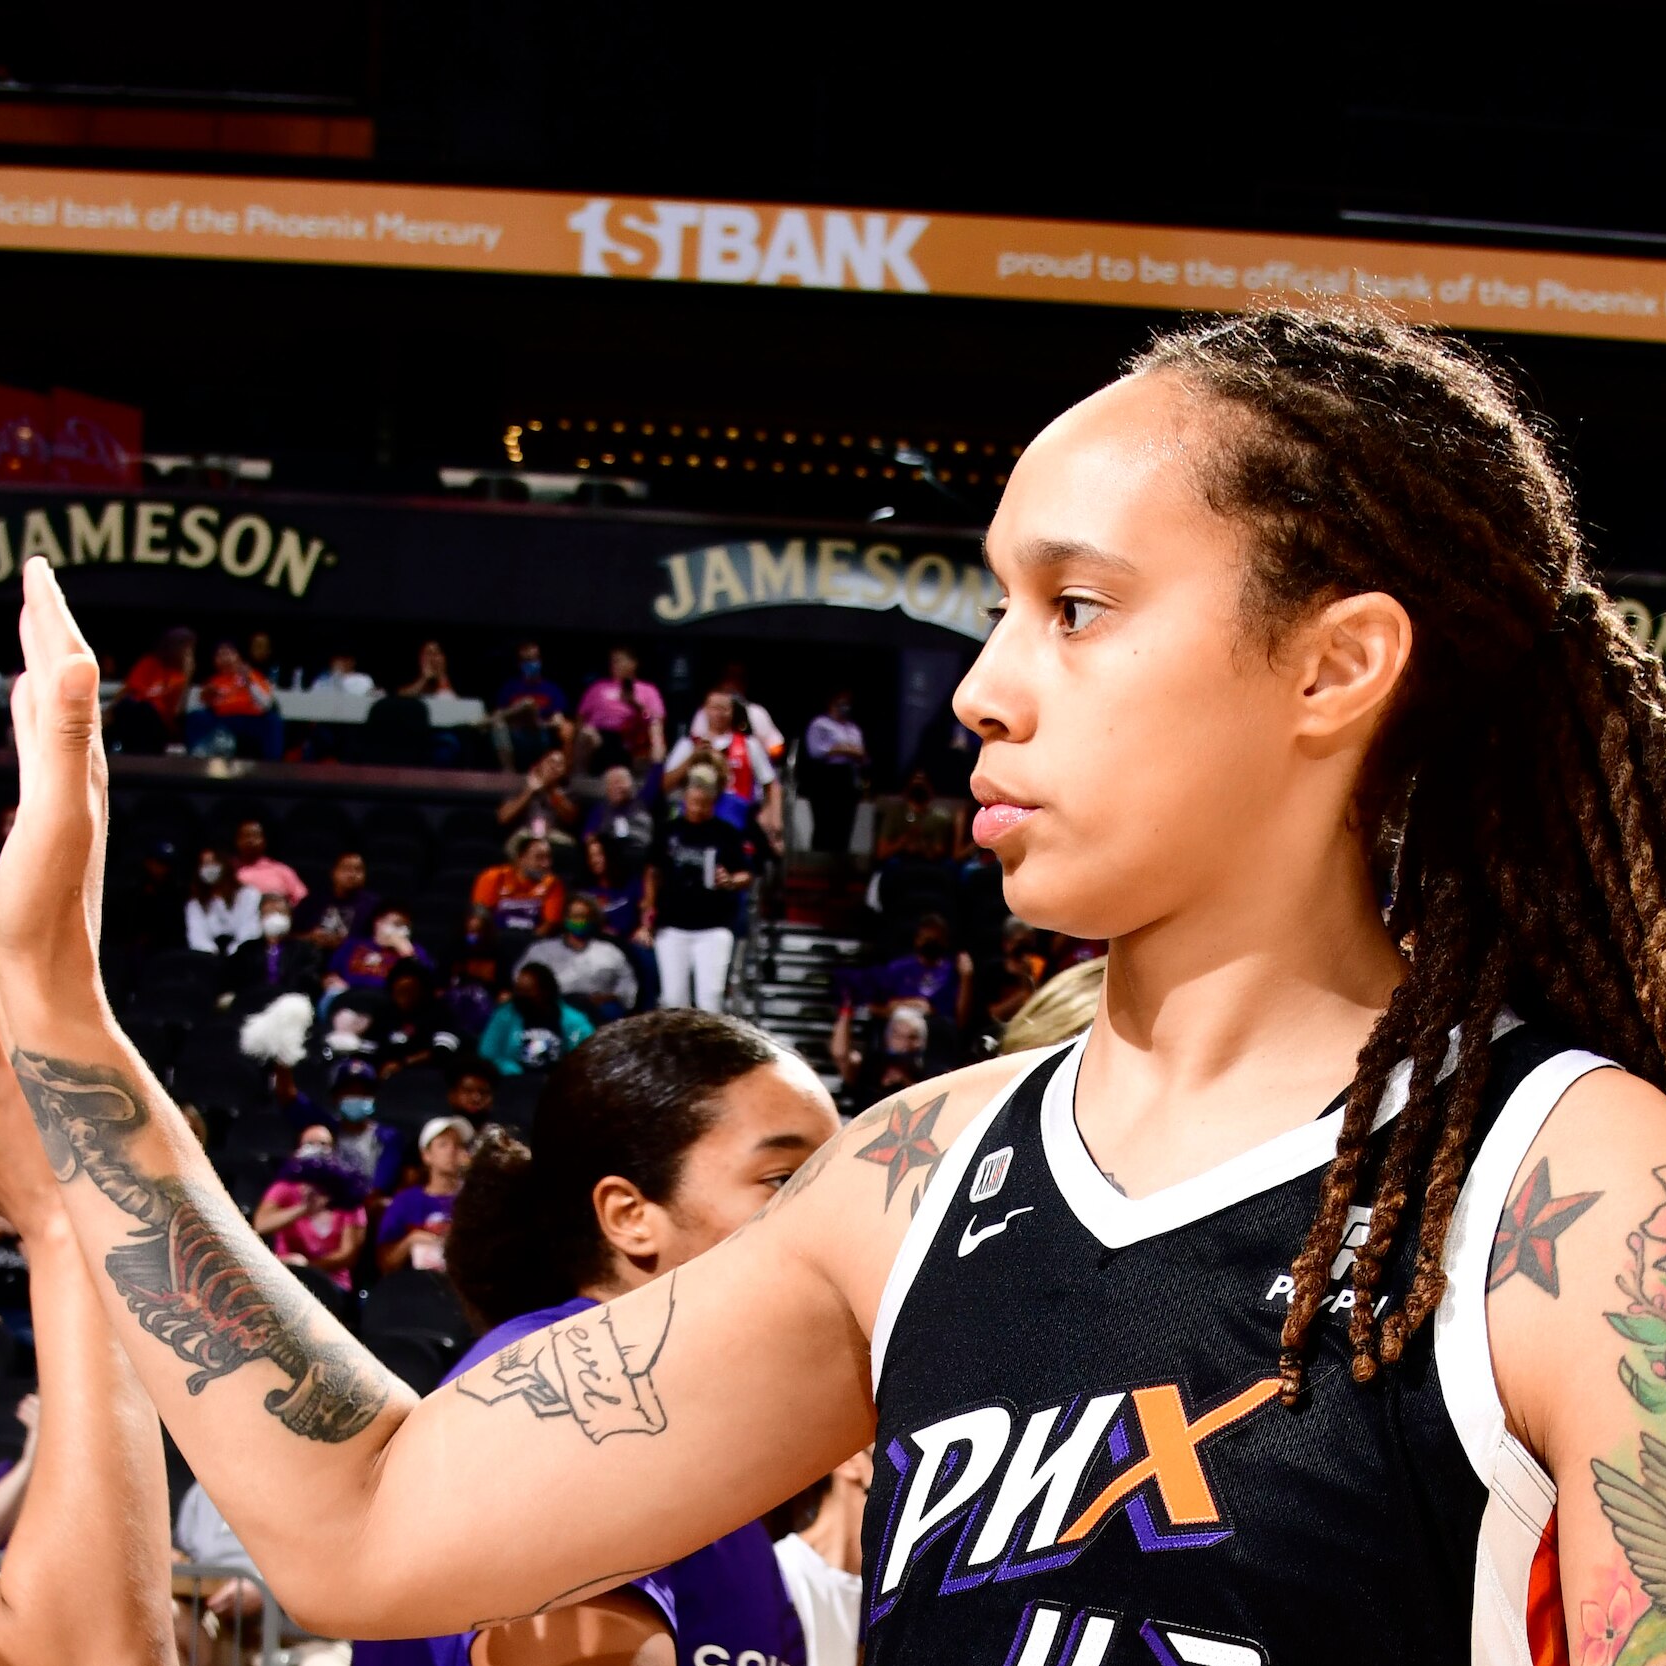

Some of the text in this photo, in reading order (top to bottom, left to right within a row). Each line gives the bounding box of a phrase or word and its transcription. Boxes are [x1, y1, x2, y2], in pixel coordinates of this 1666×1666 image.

[61, 198, 135, 230] bank
[145, 201, 183, 232] of
[186, 204, 239, 235] the
[244, 204, 367, 240] Phoenix
[374, 211, 502, 253] Mercury
[997, 250, 1093, 280] proud
[1097, 255, 1133, 282] to
[1138, 254, 1179, 285] be
[1183, 258, 1237, 289] the
[1241, 260, 1350, 295] official
[1355, 267, 1430, 299] bank
[1438, 273, 1475, 304] of
[1478, 277, 1531, 308] the
[1536, 279, 1660, 317] Phoenix
[653, 538, 999, 634] JAMESON
